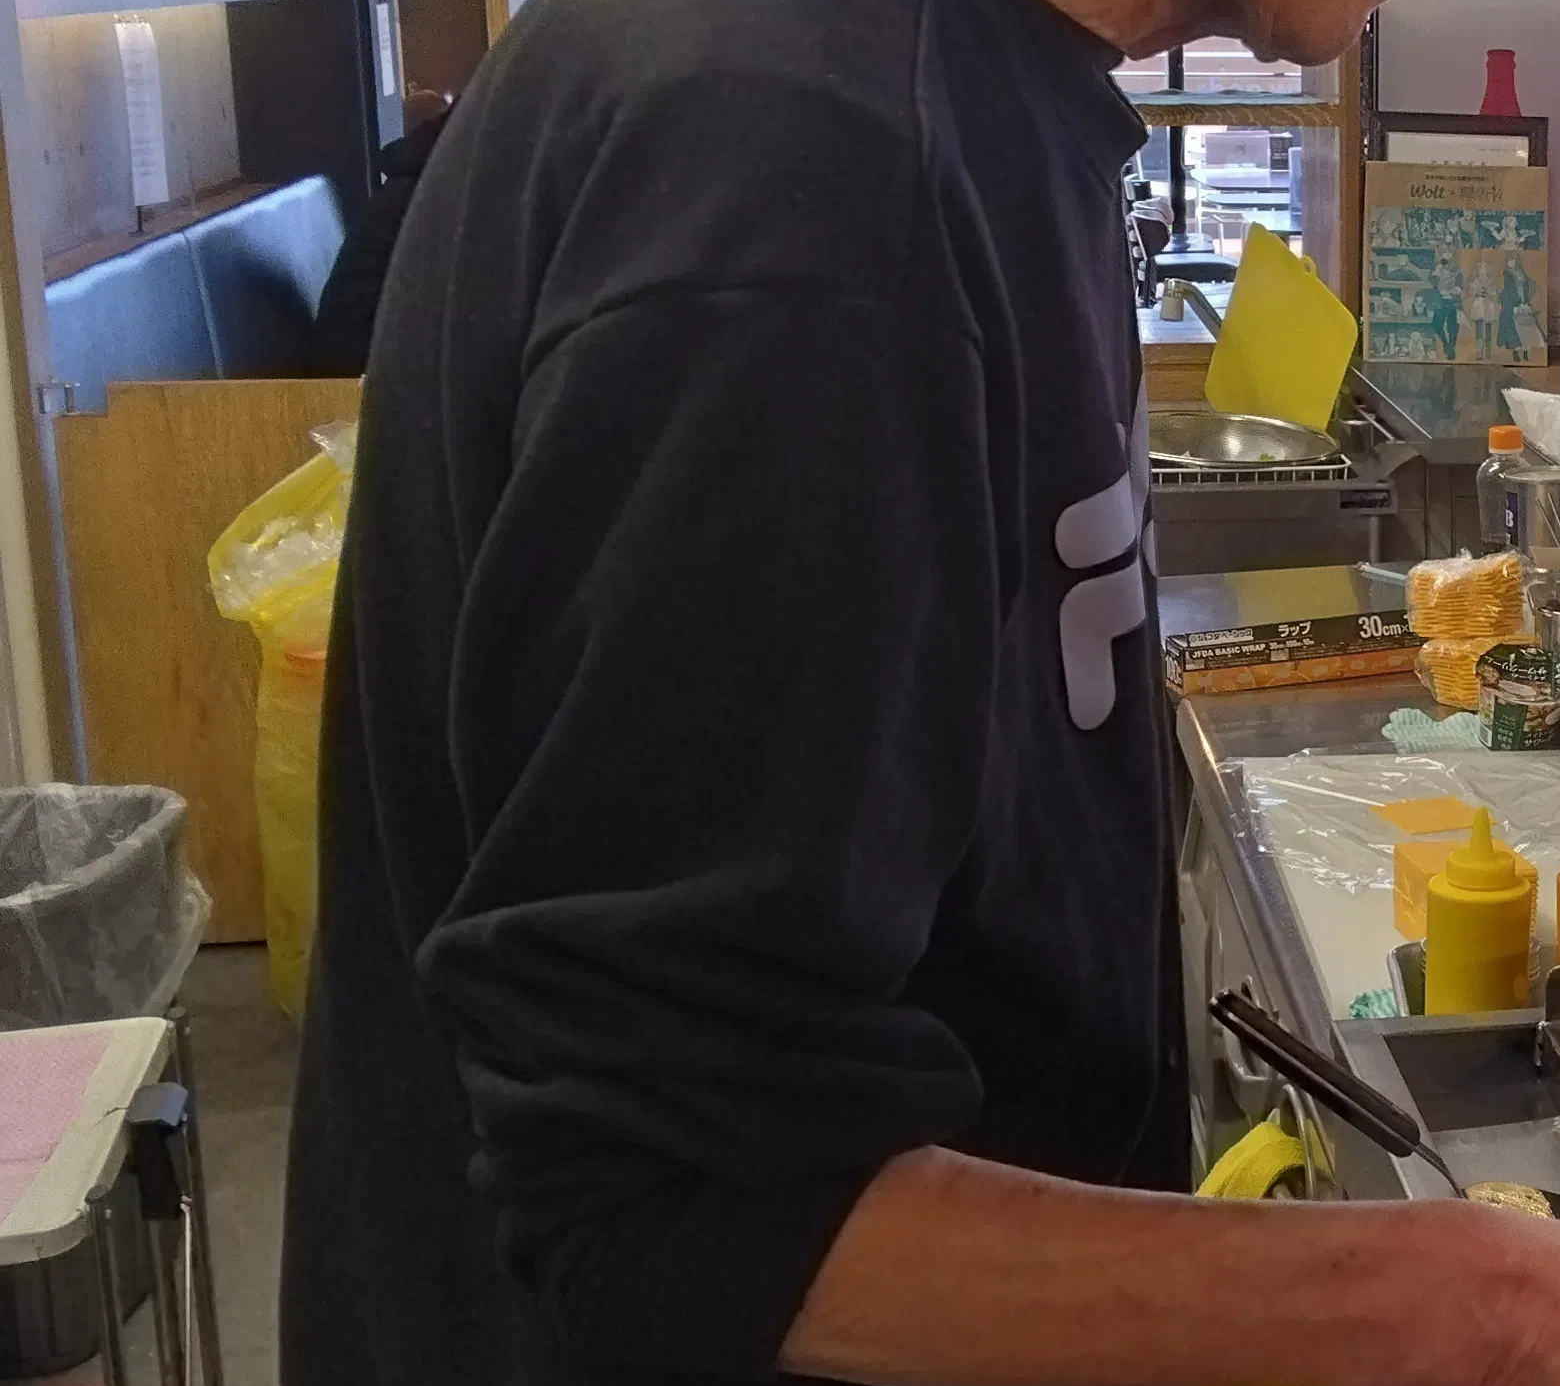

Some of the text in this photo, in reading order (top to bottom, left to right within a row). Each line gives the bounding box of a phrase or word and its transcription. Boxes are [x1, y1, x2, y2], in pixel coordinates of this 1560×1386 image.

[1410, 184, 1445, 199] Wolt
[1278, 621, 1312, 638] ラップ
[1215, 645, 1240, 656] BASIC
[1241, 643, 1266, 654] WRAP
